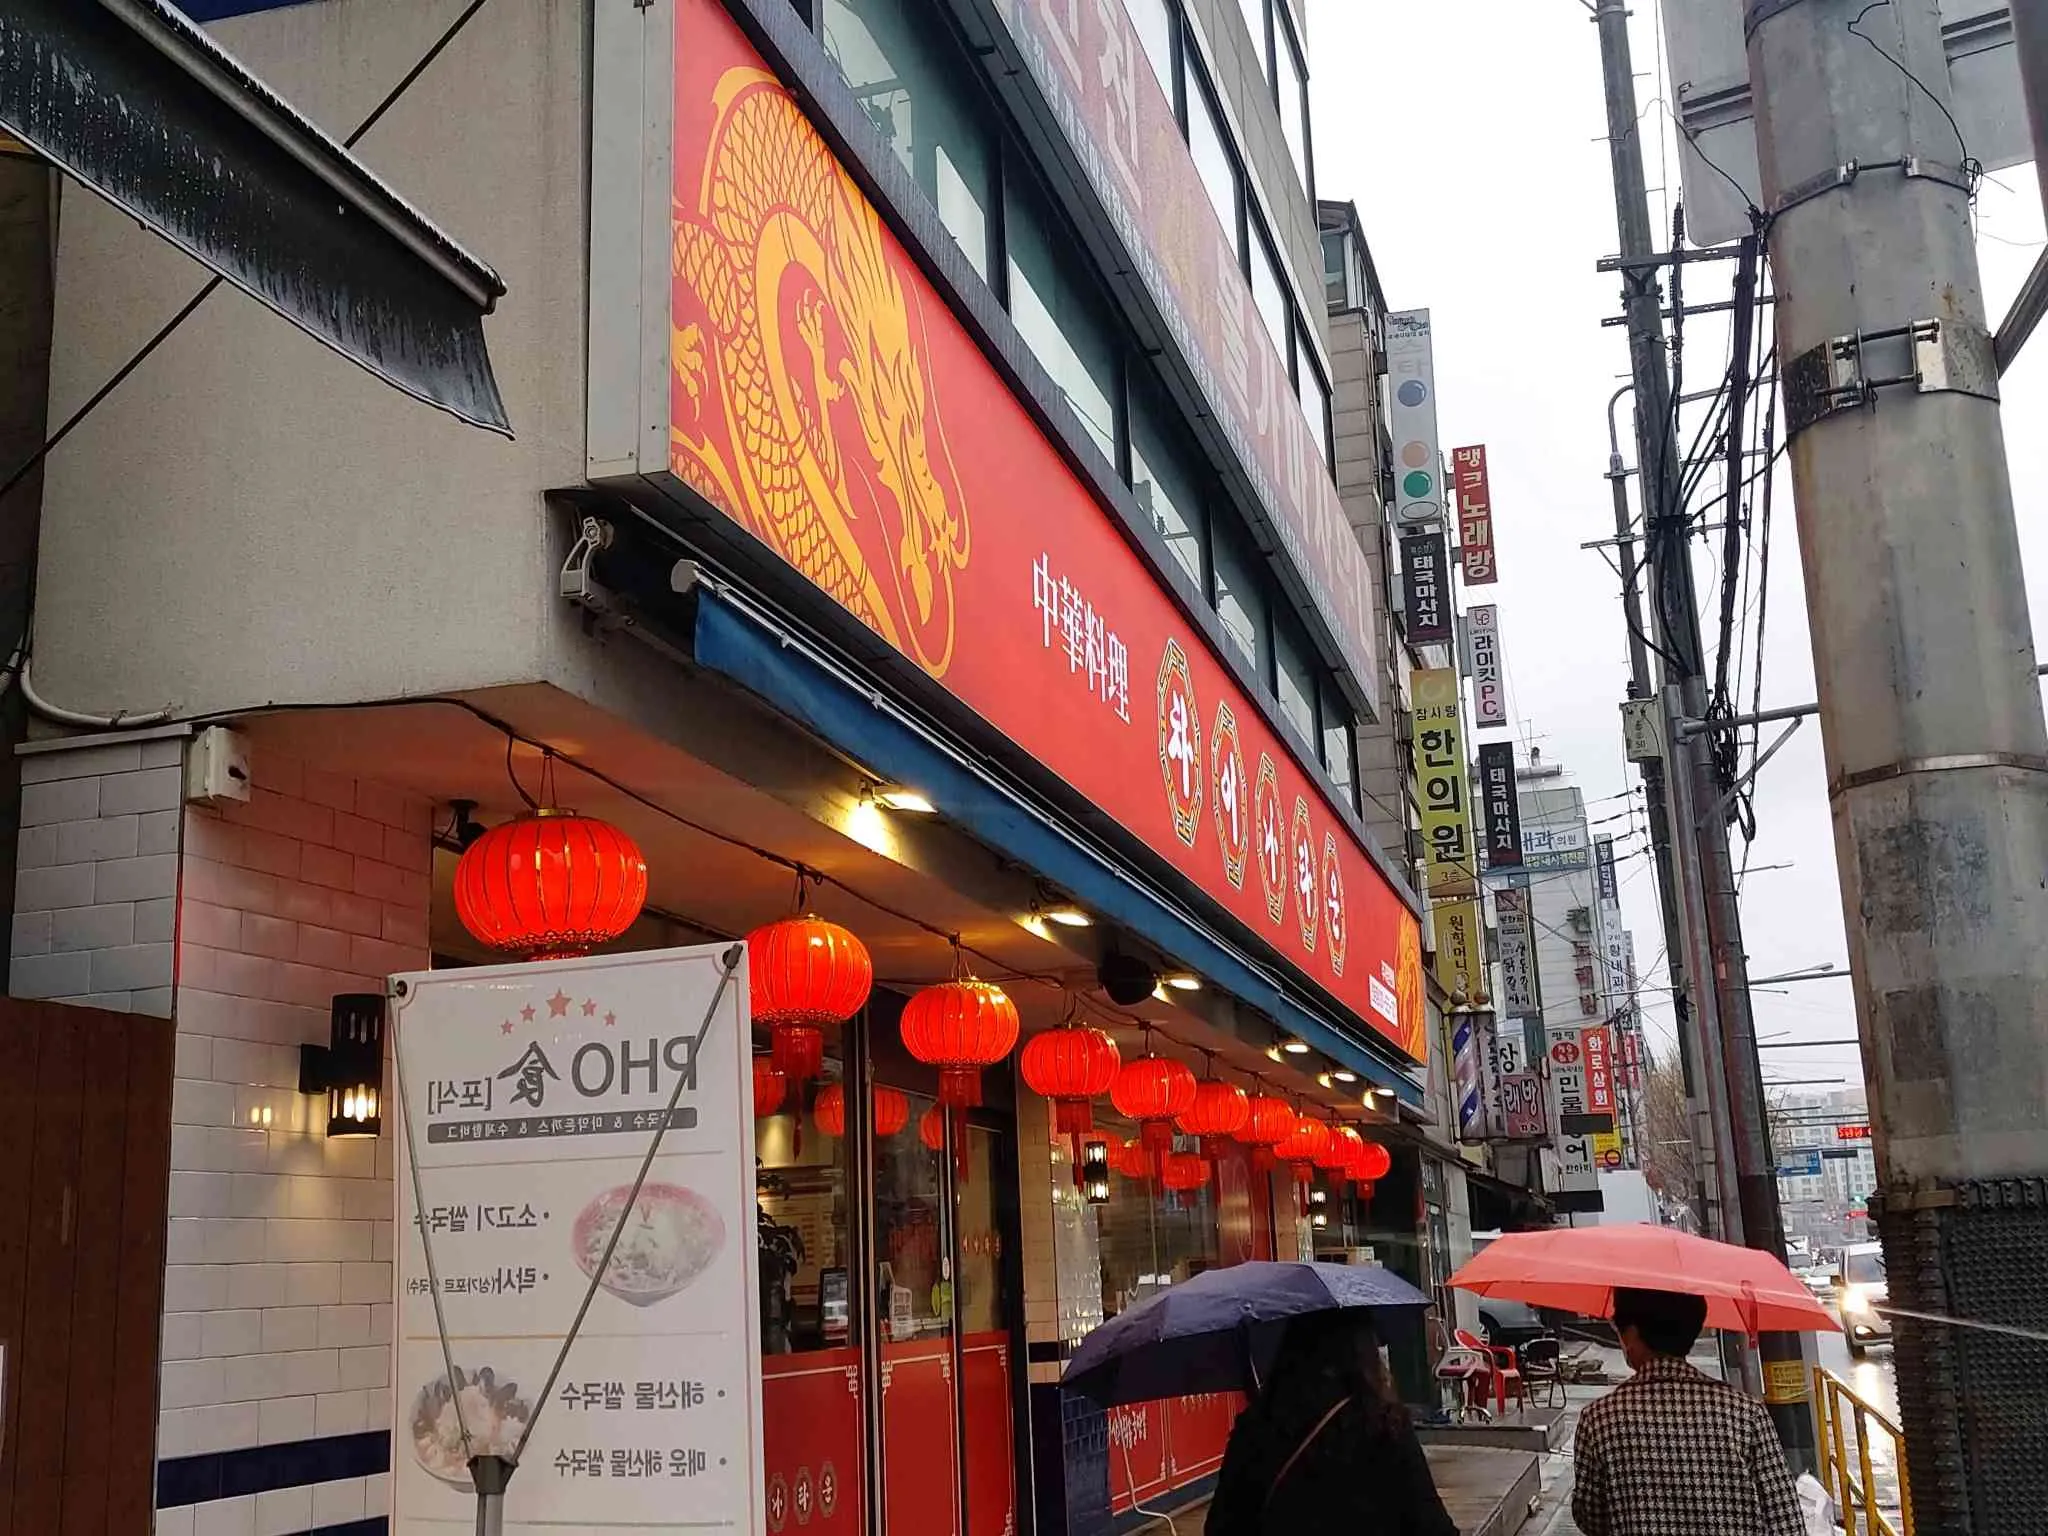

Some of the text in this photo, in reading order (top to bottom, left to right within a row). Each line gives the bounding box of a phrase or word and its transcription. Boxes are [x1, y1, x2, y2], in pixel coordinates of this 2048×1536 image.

[1412, 555, 1438, 626] 태국마사지
[1032, 551, 1131, 725] 中華料理
[1420, 728, 1466, 864] 한의원
[1490, 767, 1513, 849] 태국마사지
[1559, 1075, 1588, 1162] 민물어
